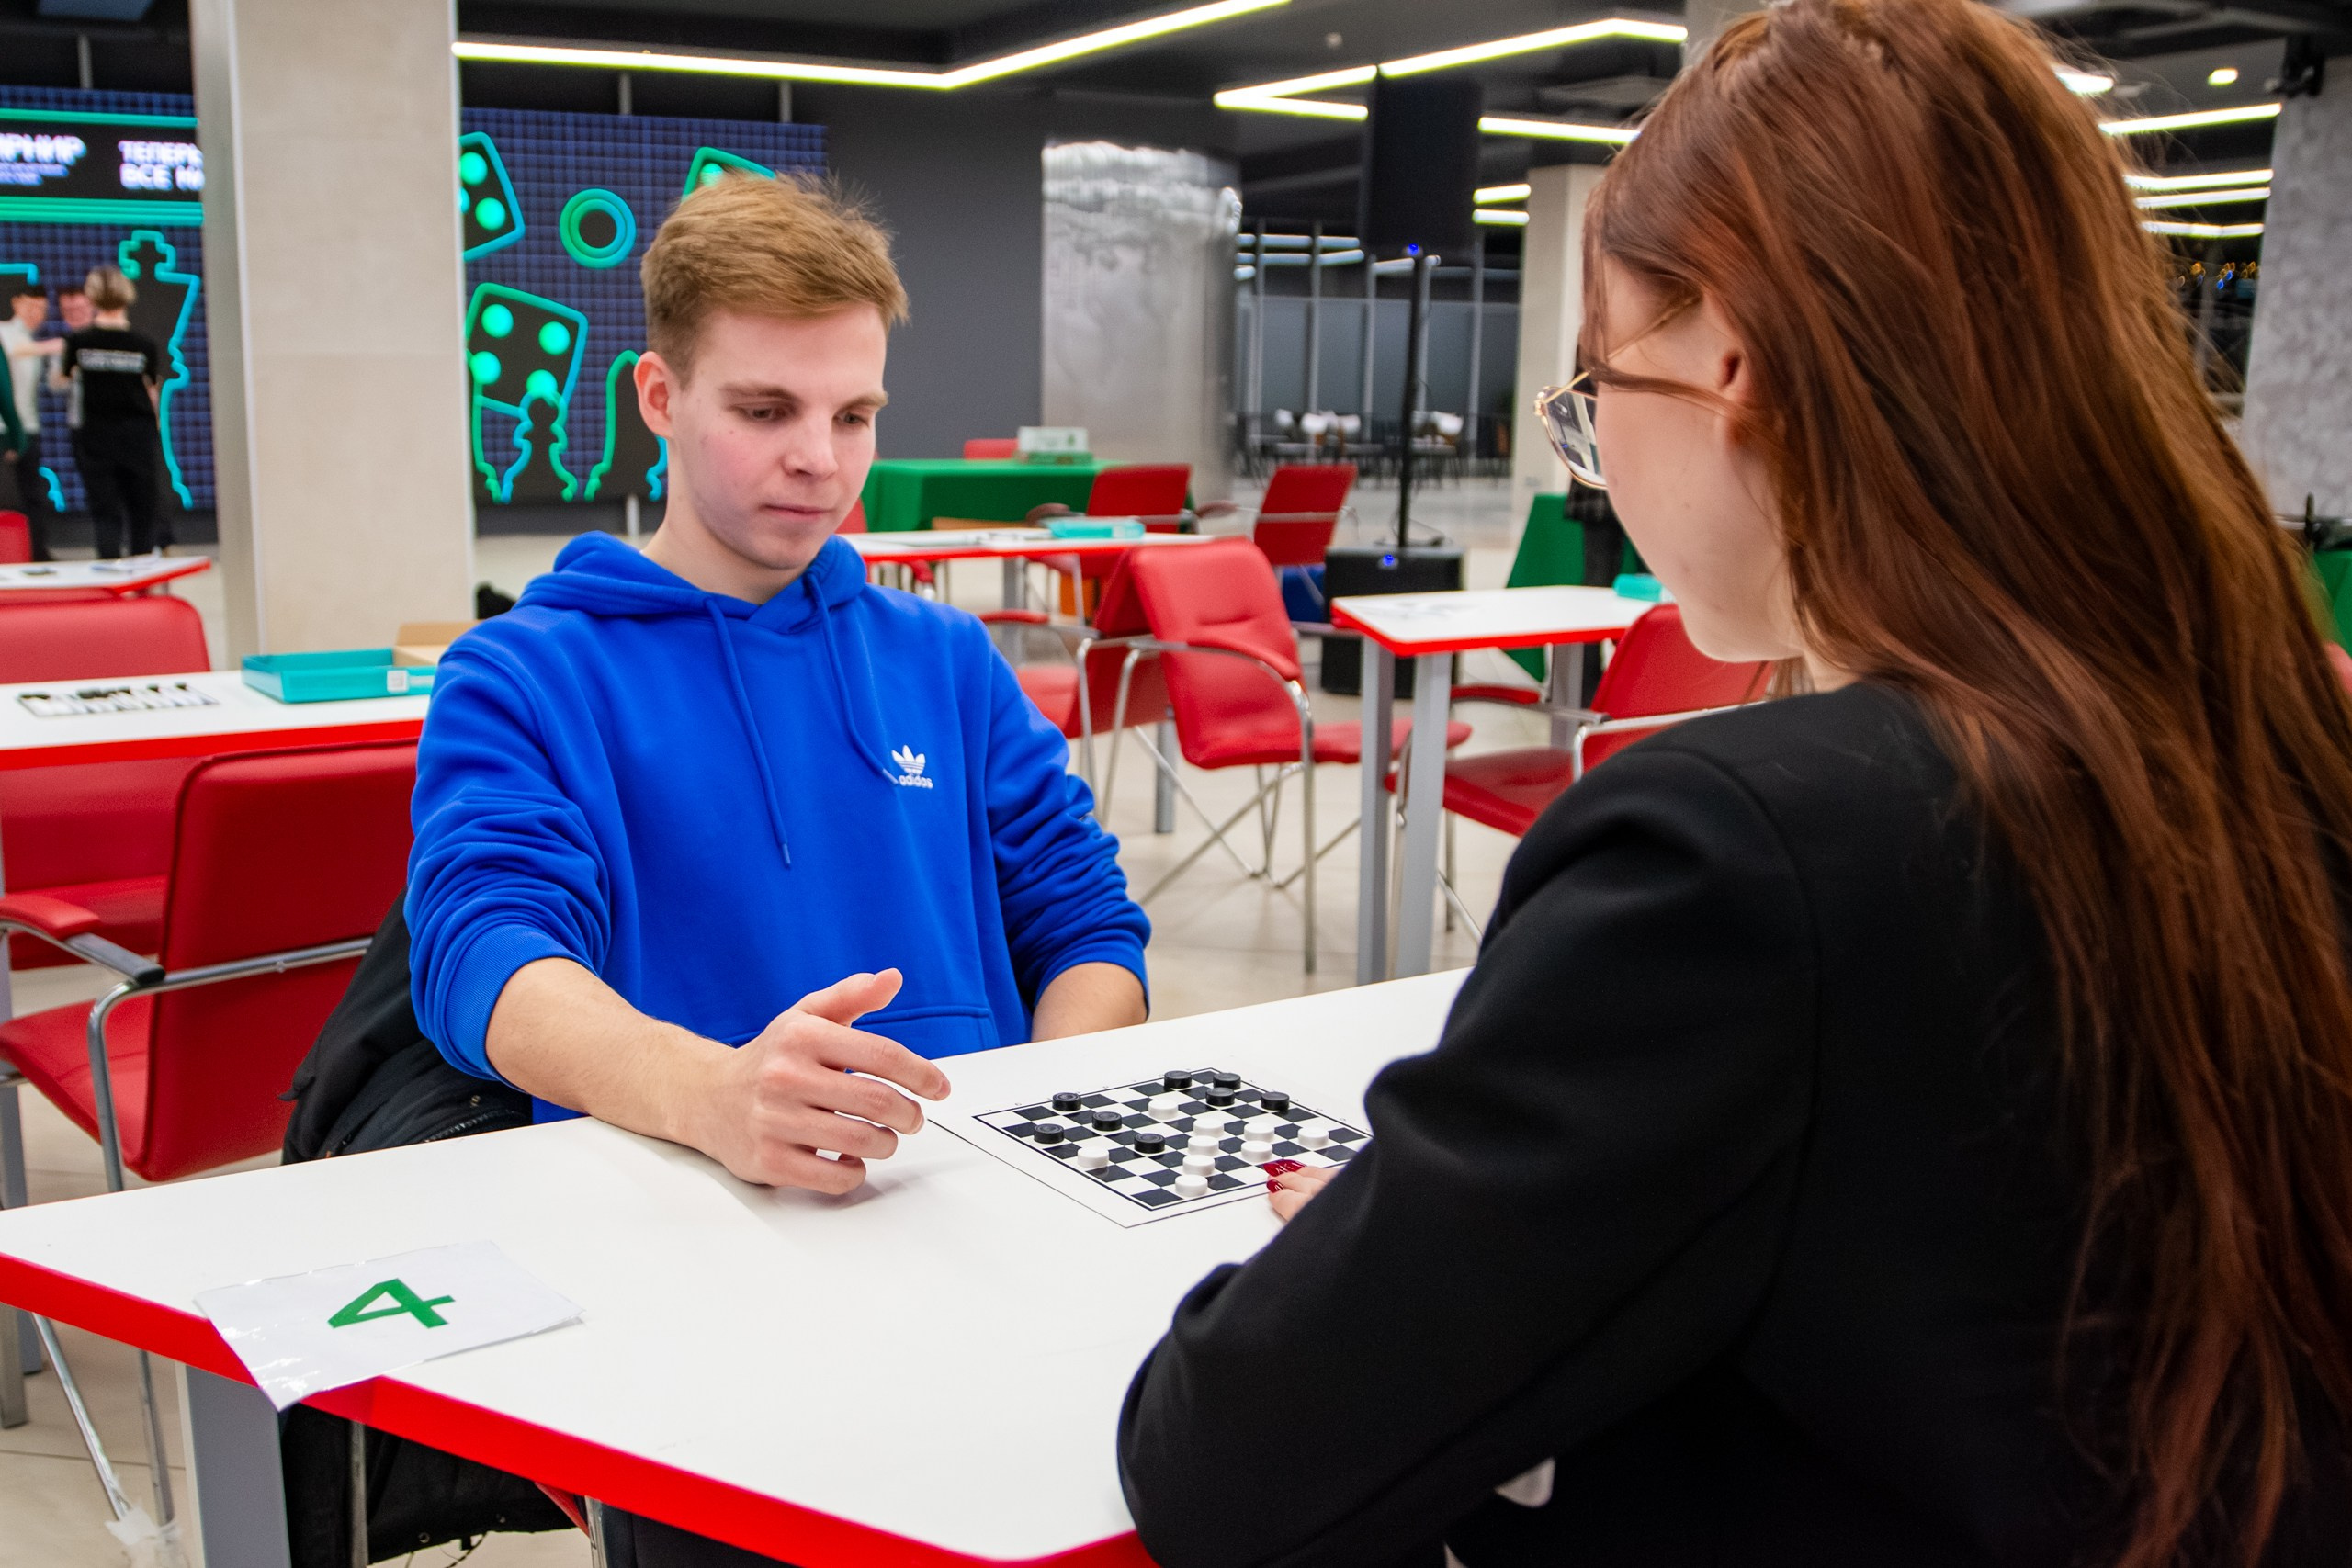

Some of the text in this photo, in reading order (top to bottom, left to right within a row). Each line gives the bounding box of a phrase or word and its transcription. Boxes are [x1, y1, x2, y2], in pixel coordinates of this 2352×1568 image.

[120, 163, 173, 190] ВСЕ
[899, 773, 933, 789] adidas
[327, 1278, 456, 1329] 4
